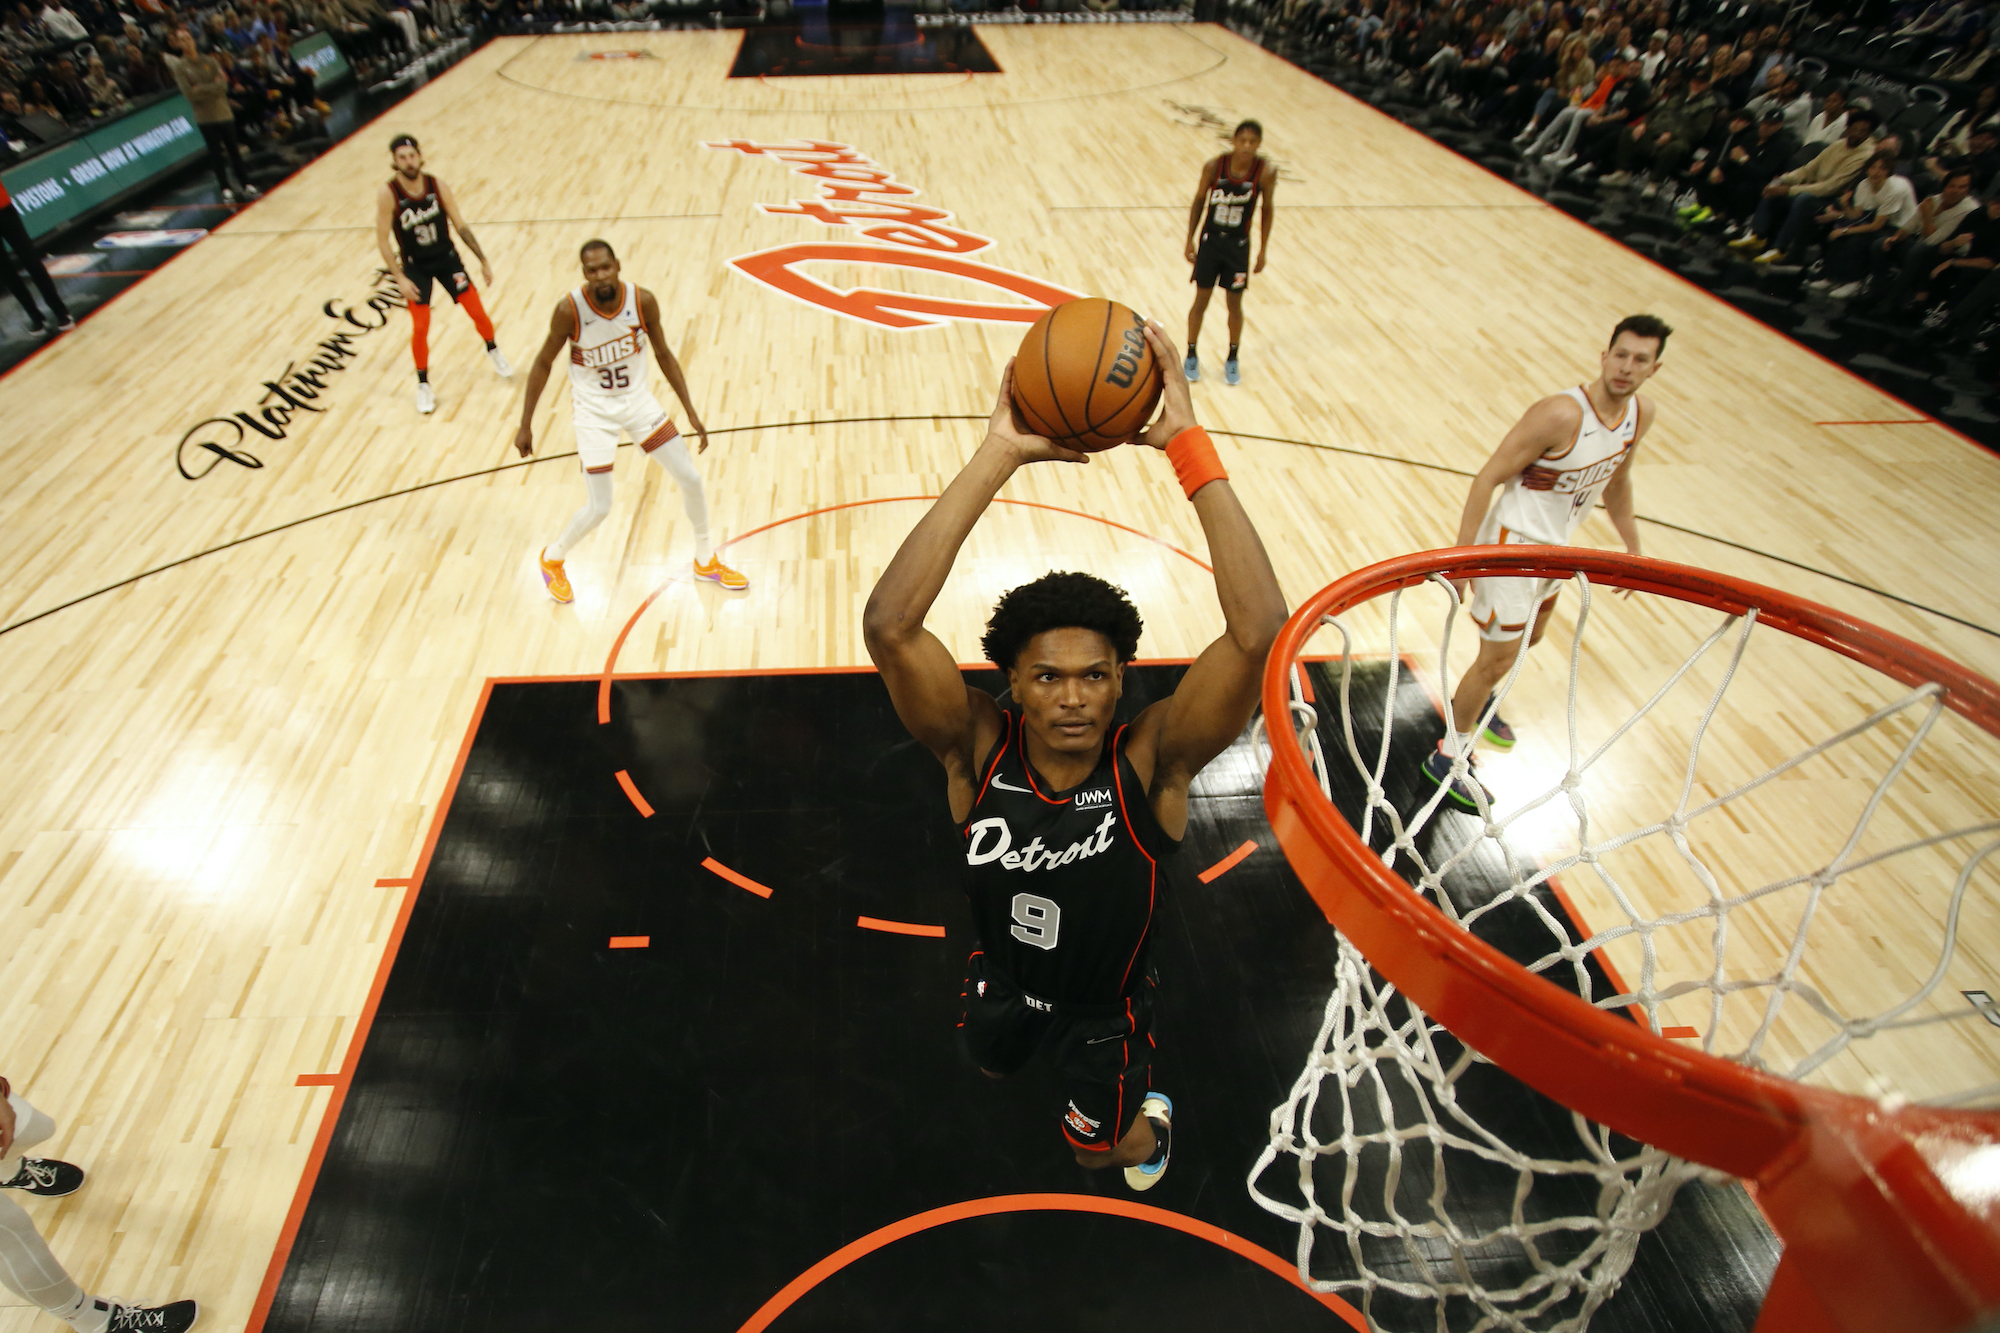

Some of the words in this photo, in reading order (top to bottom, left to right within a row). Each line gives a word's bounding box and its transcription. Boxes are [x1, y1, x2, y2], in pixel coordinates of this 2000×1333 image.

[16, 177, 66, 212] PISTONS
[99, 147, 129, 172] NOW
[413, 222, 438, 246] 31
[700, 138, 1163, 331] Detroit
[581, 335, 635, 368] SUNS
[1105, 310, 1147, 390] Wilso
[598, 364, 630, 390] 35
[176, 332, 358, 480] Platinum
[1552, 453, 1624, 494] SUNS
[1074, 788, 1112, 806] UWM
[966, 810, 1117, 873] Detroit
[1010, 892, 1061, 951] 9
[1024, 994, 1053, 1013] DET
